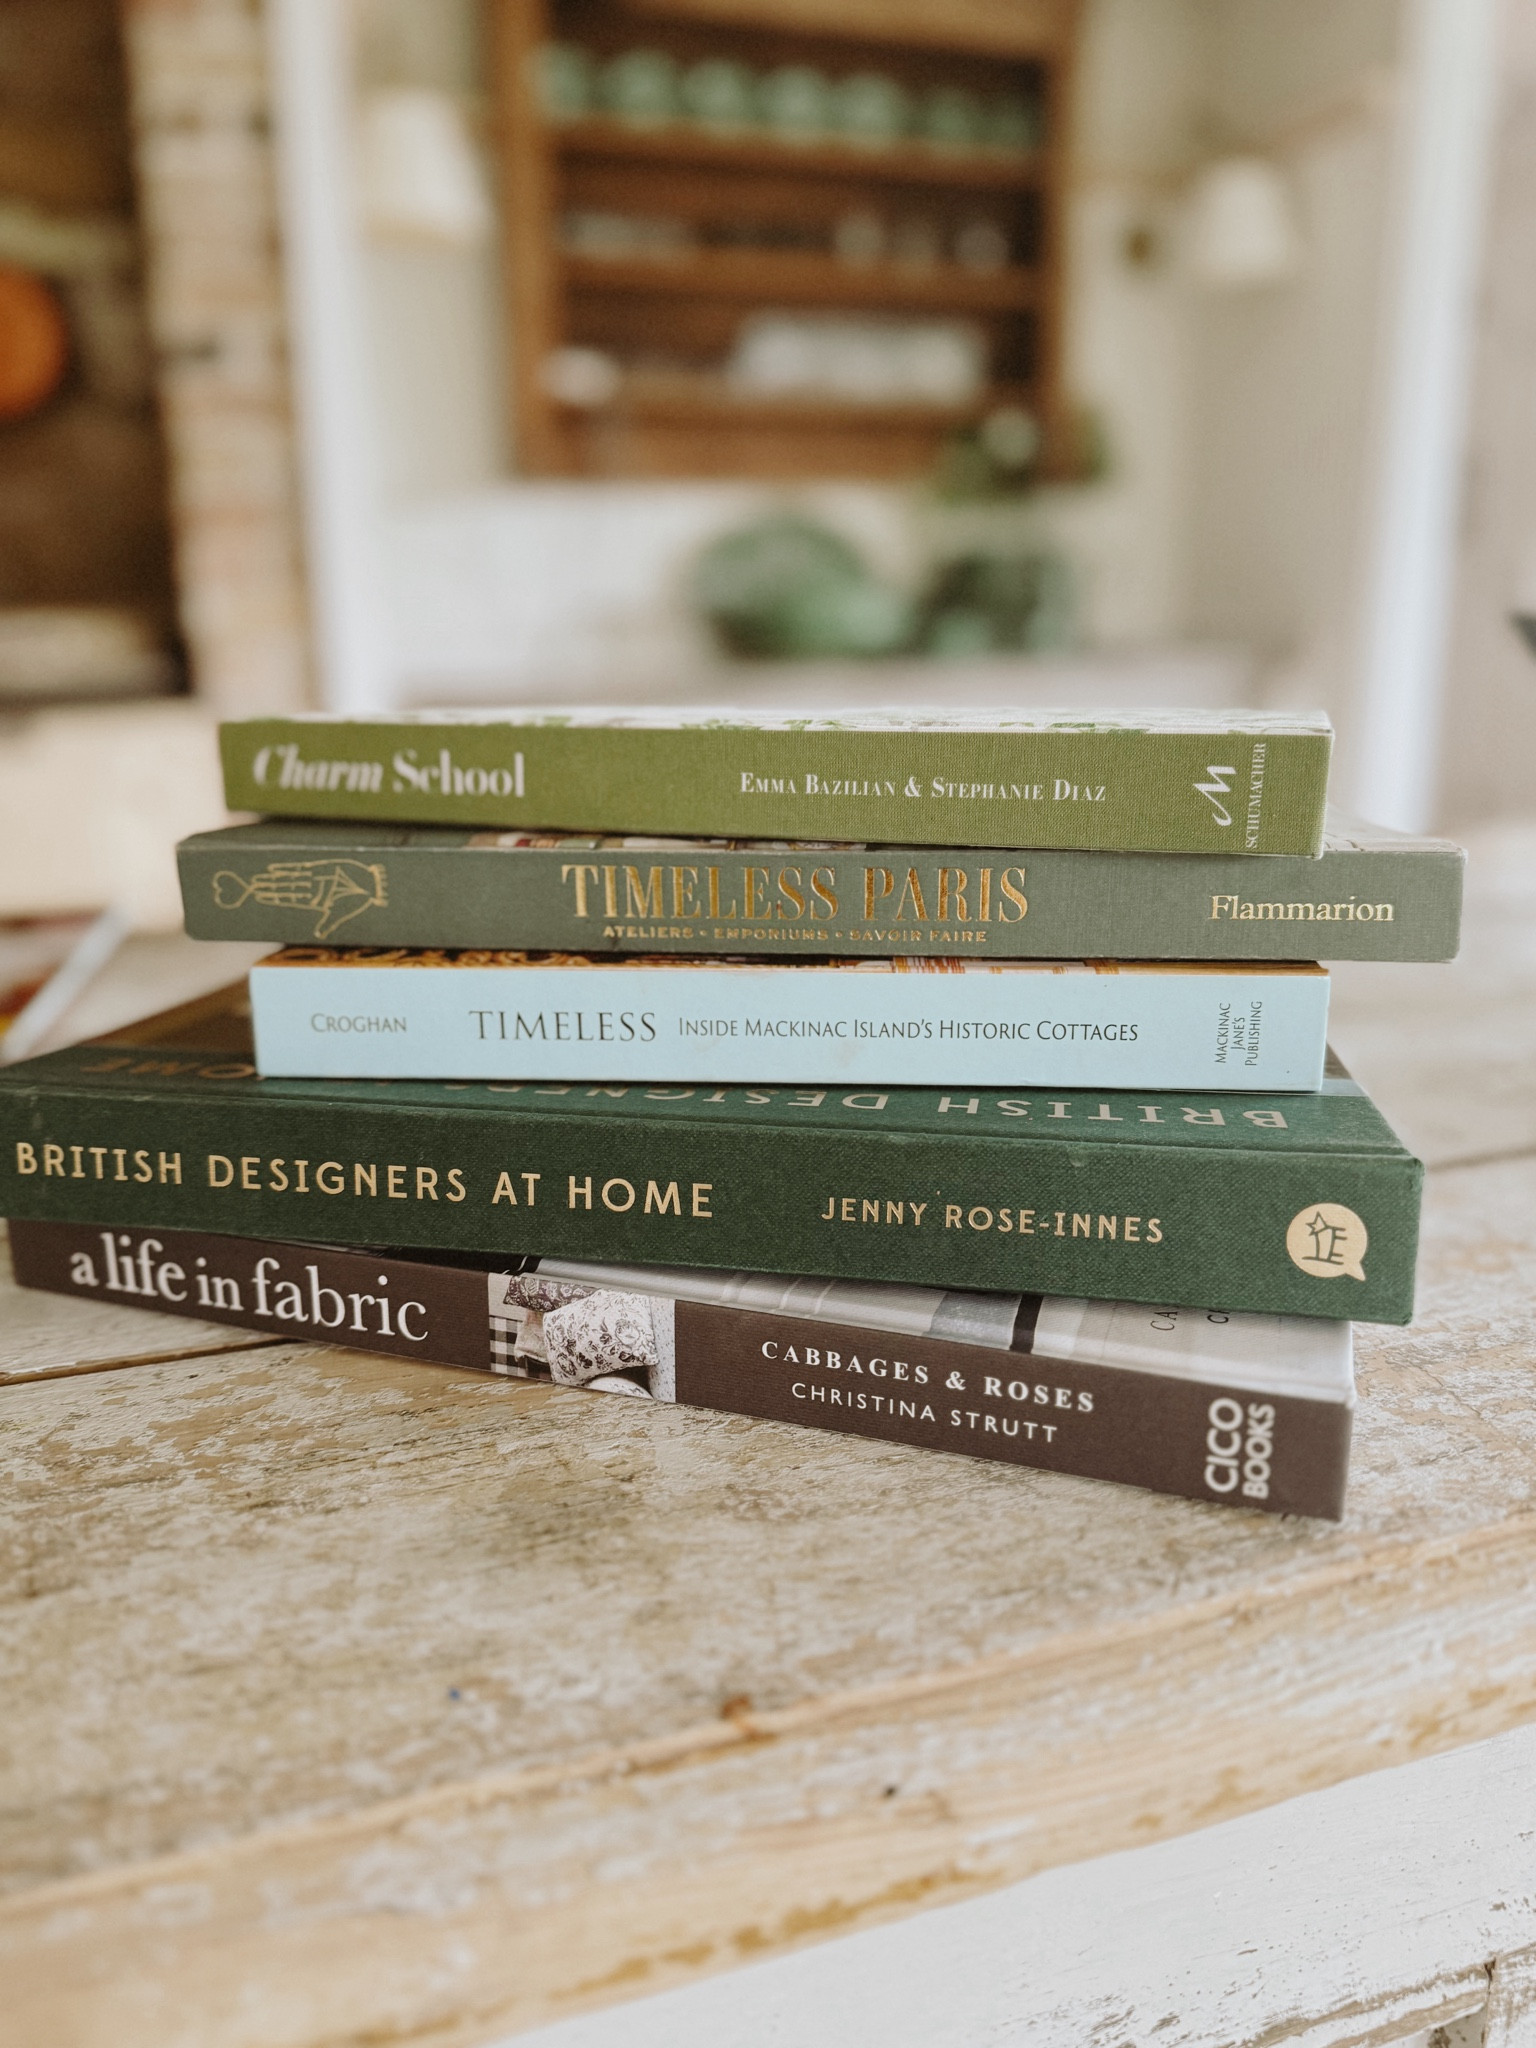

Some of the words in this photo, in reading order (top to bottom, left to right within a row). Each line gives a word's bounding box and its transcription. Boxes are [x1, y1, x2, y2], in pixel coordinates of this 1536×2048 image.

[253, 744, 383, 793] Charm
[393, 749, 525, 797] School
[740, 772, 797, 794] EMMA
[904, 777, 923, 798] &
[1053, 779, 1106, 802] DIAZ
[1245, 742, 1267, 849] SCHUMACHER
[561, 864, 839, 922] TIMELESS
[863, 866, 1029, 924] PARIS
[1208, 895, 1395, 922] Flammarion
[603, 926, 694, 940] ATELIERS
[714, 927, 829, 941] EMPORIUMS
[849, 928, 922, 942] SAVOIR
[929, 928, 988, 943] FAIRE
[468, 1010, 657, 1042] TIMELESS
[1214, 1002, 1231, 1064] MACKINAC
[1245, 1000, 1263, 1066] PUBLISHING
[936, 1096, 1290, 1130] BRITISH
[15, 1141, 183, 1185] BRITISH
[207, 1154, 467, 1203] DESIGNERS
[491, 1171, 541, 1207] AT
[568, 1175, 714, 1218] HOME
[821, 1197, 928, 1227] JENNY
[945, 1205, 1164, 1244] ROSE-INNES
[70, 1252, 100, 1289] a
[100, 1232, 188, 1302] life
[195, 1256, 244, 1311] in
[253, 1257, 430, 1342] fabric
[761, 1339, 930, 1386] CABBAGES
[944, 1370, 967, 1391] &
[983, 1376, 1095, 1414] ROSES
[791, 1382, 936, 1422] CHRISTINA
[950, 1409, 1058, 1444] STRUTT
[1204, 1397, 1244, 1494] CICO
[1242, 1403, 1277, 1500] BOOKS
